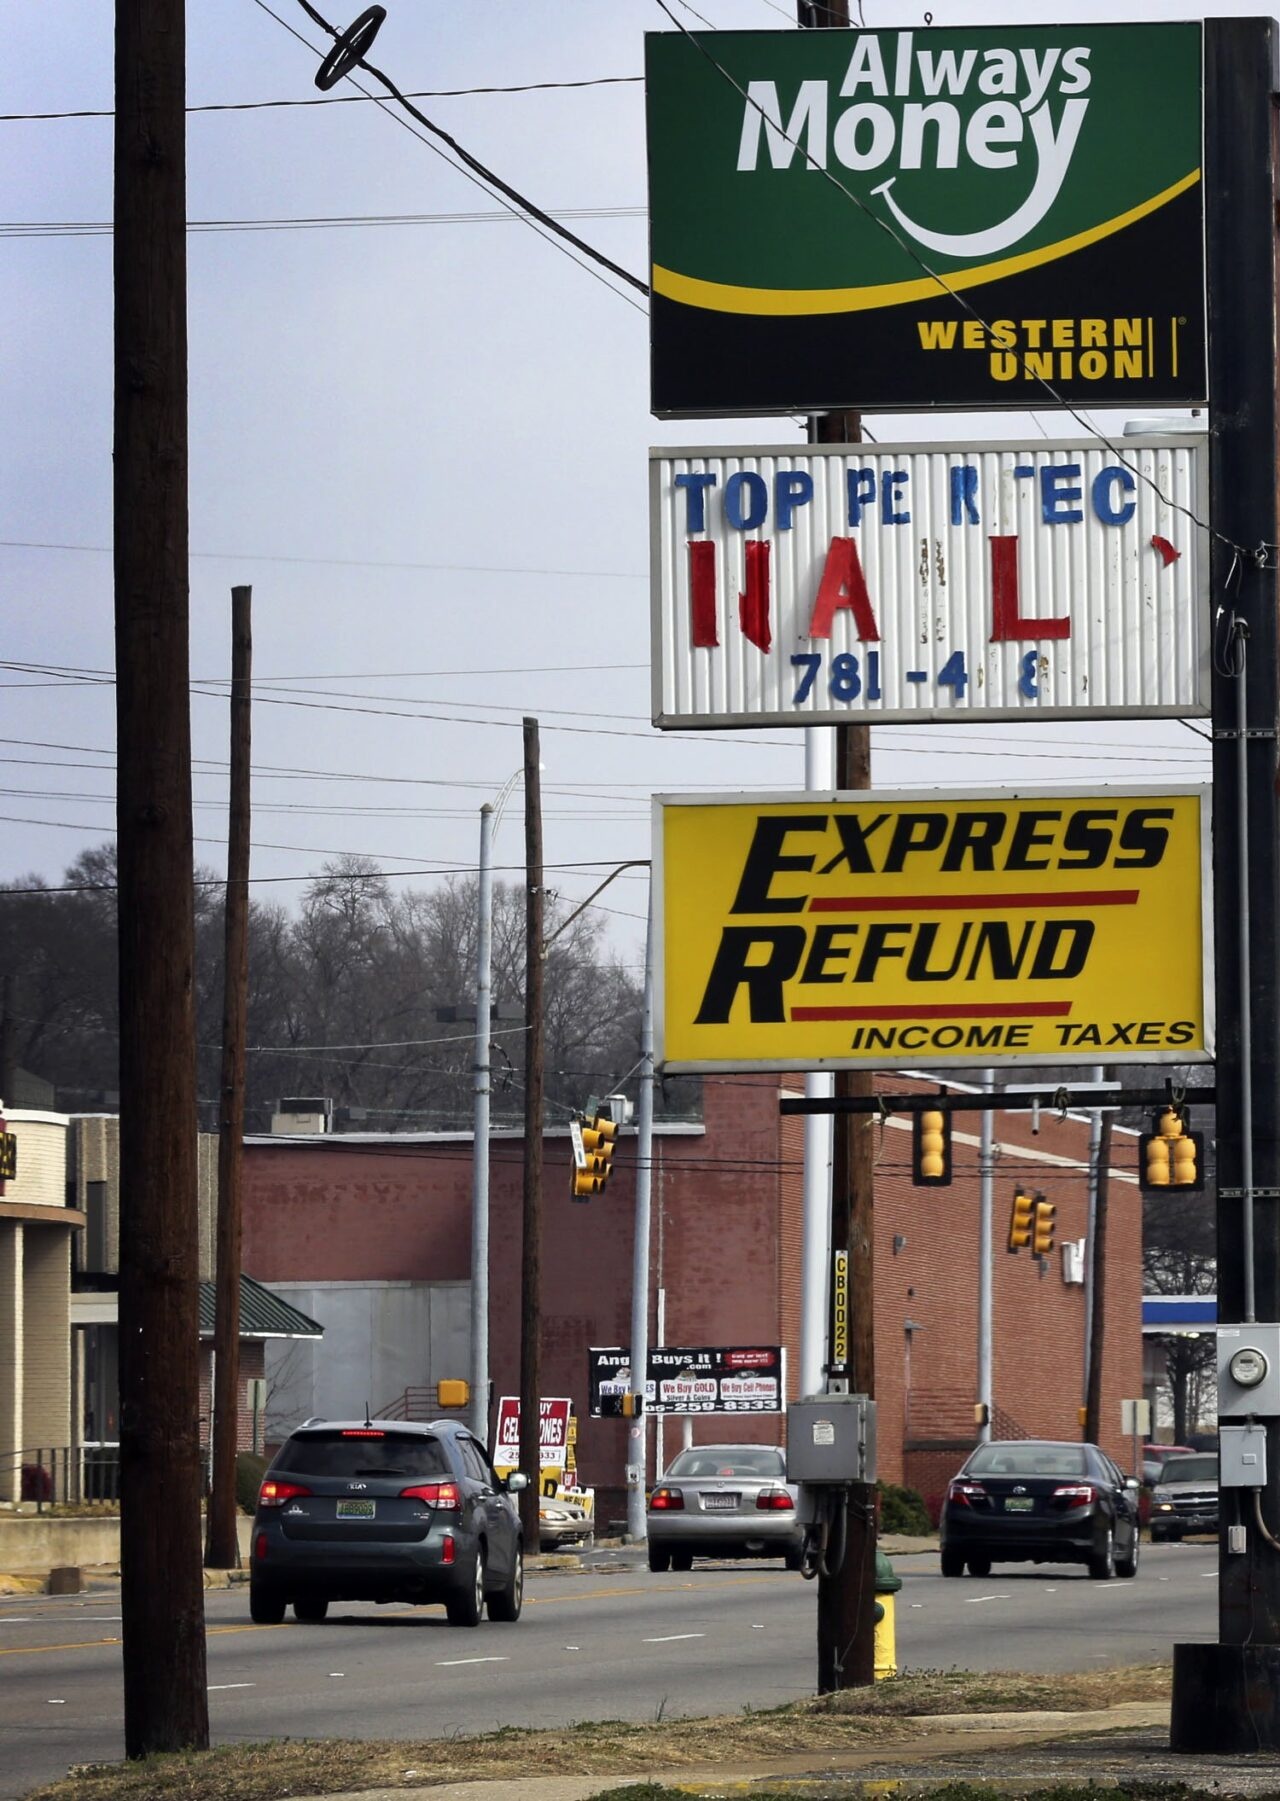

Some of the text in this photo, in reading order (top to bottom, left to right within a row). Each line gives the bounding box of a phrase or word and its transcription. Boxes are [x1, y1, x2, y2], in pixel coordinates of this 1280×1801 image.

[840, 32, 1093, 113] Always
[736, 80, 1090, 257] Money
[917, 318, 1143, 351] WESTERN
[990, 350, 1143, 381] UNION
[675, 470, 814, 533] TOP
[729, 808, 1175, 915] EXPRESS
[693, 920, 1096, 1024] REFUND
[851, 1021, 1197, 1050] INCOME TAXES
[597, 1355, 630, 1366] Ang
[652, 1355, 693, 1365] Buys
[663, 1384, 675, 1393] We
[694, 1383, 715, 1392] GOLD
[539, 1403, 552, 1415] UY
[646, 1401, 777, 1412] 05-259-8333
[503, 1417, 520, 1443] CEL
